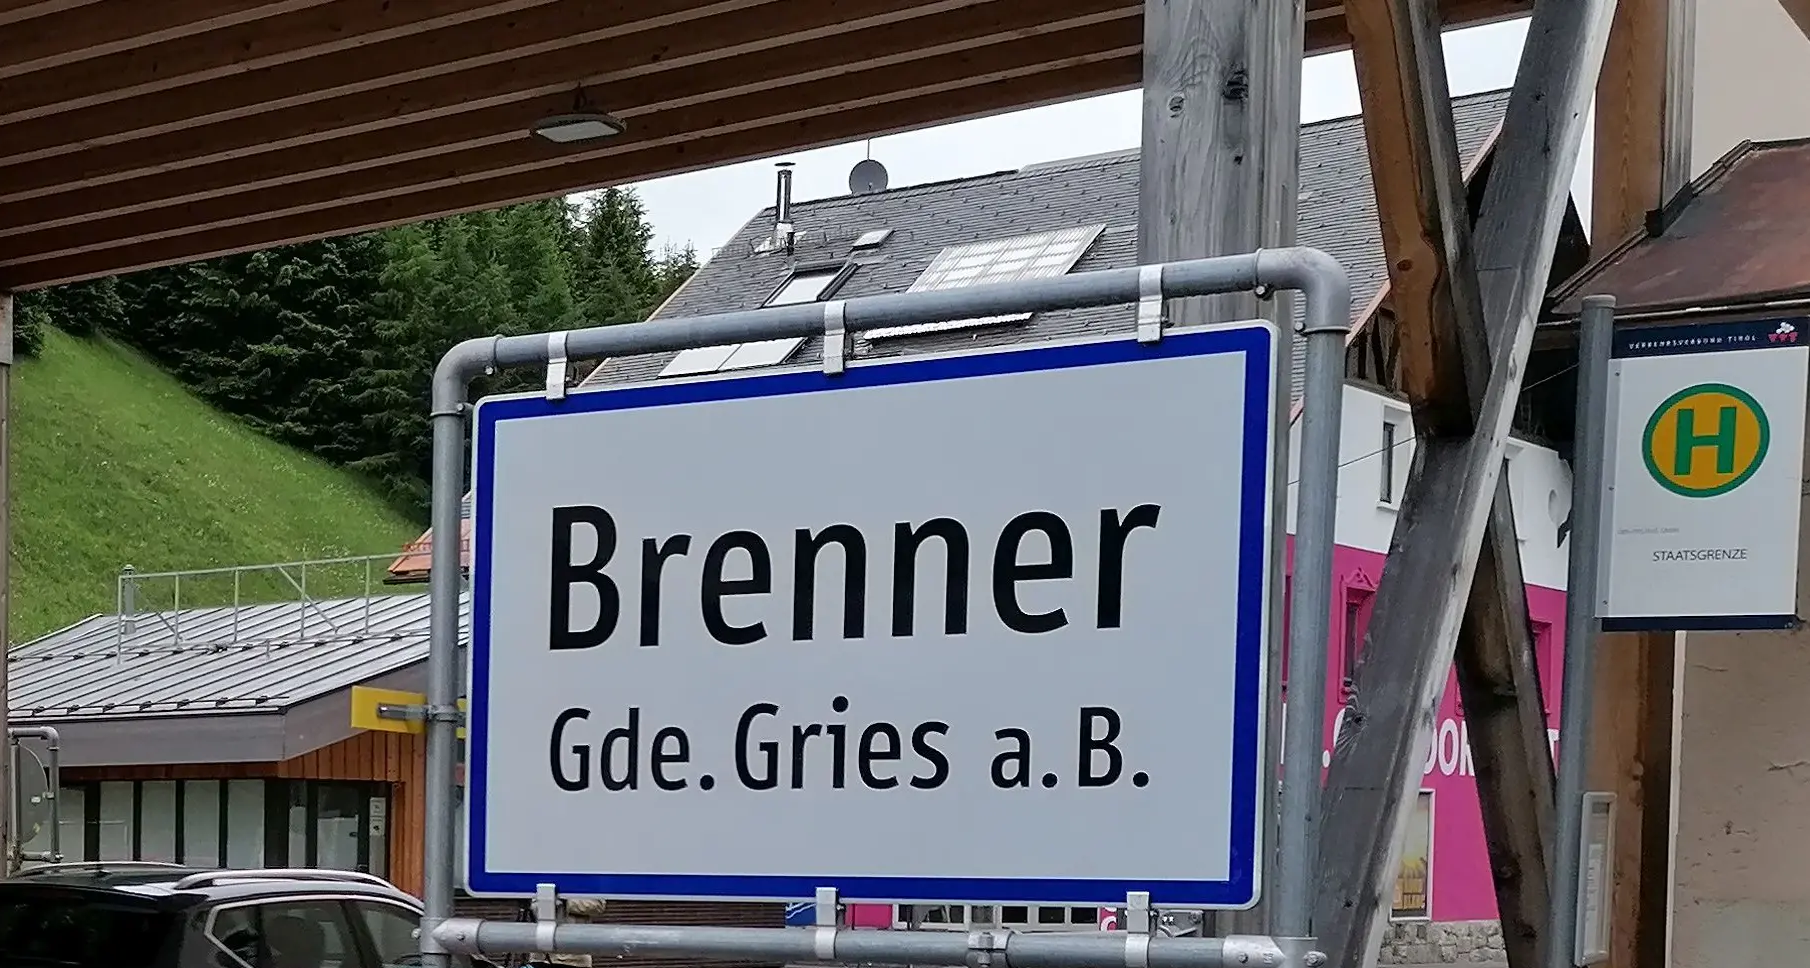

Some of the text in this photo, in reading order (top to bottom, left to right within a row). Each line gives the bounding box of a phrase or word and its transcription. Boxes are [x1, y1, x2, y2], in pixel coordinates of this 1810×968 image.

[1674, 406, 1737, 476] H
[549, 503, 1162, 650] Brenner
[1652, 548, 1748, 562] STAATSGRENZE
